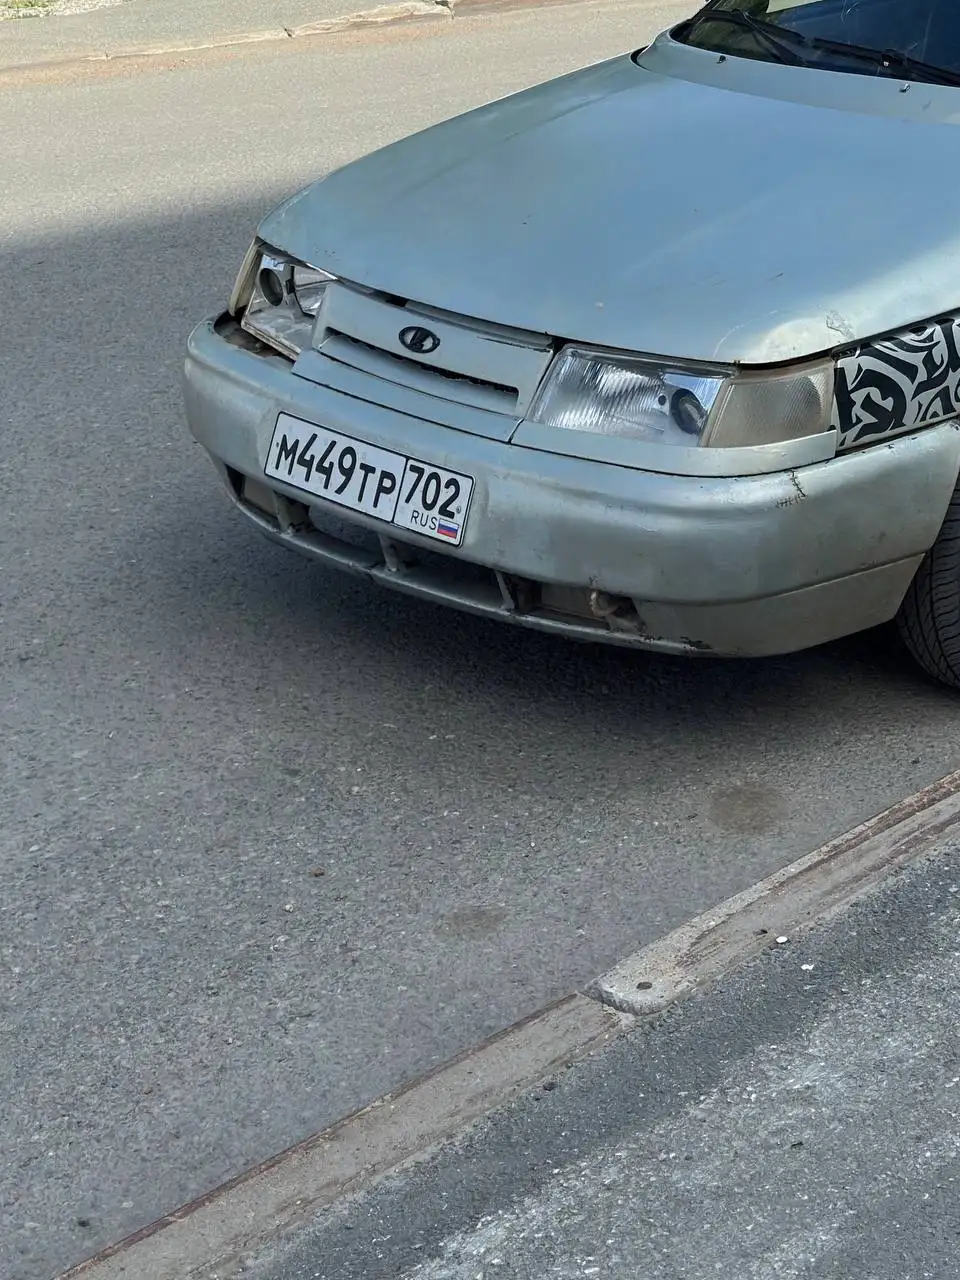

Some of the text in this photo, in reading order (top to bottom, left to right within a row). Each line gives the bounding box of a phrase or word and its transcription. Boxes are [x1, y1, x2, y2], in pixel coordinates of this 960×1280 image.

[275, 433, 460, 520] М449ТР 702
[410, 509, 438, 531] RUS
